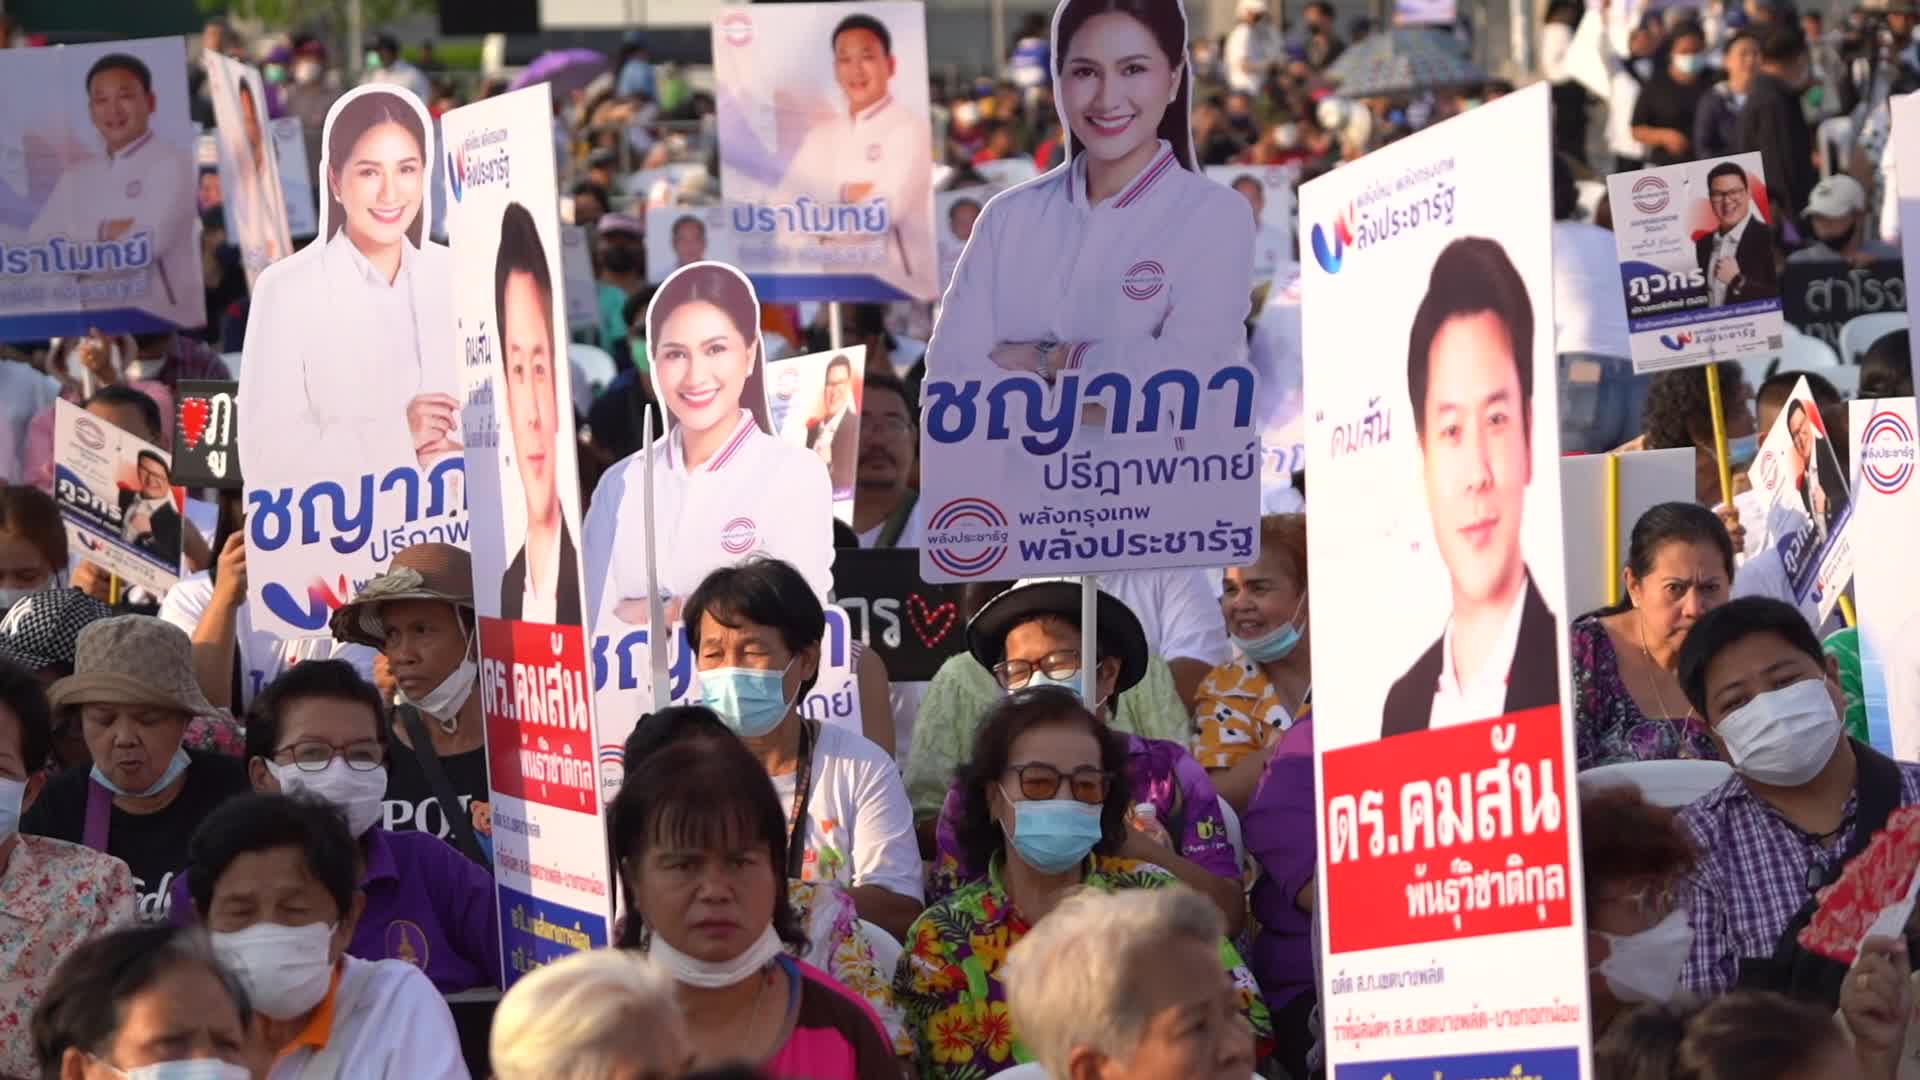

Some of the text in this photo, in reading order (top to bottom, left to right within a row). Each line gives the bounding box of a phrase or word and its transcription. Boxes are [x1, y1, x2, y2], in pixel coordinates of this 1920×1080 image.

[733, 197, 886, 233] ปราโมทย์
[1629, 267, 1705, 303] ภูวกร
[925, 366, 1255, 456] ชญาภา
[1043, 442, 1255, 496] ปรีฎาพากย์
[928, 530, 1009, 544] พลังประชารัฐ
[1019, 505, 1151, 528] พลังกรุงเทพ
[1019, 520, 1254, 562] พลังประชารัฐ
[483, 632, 588, 732] ดร.คมสัน
[1328, 723, 1562, 864] ดร.คมสัน
[1405, 853, 1566, 931] พันธุ์วิชาติกุล
